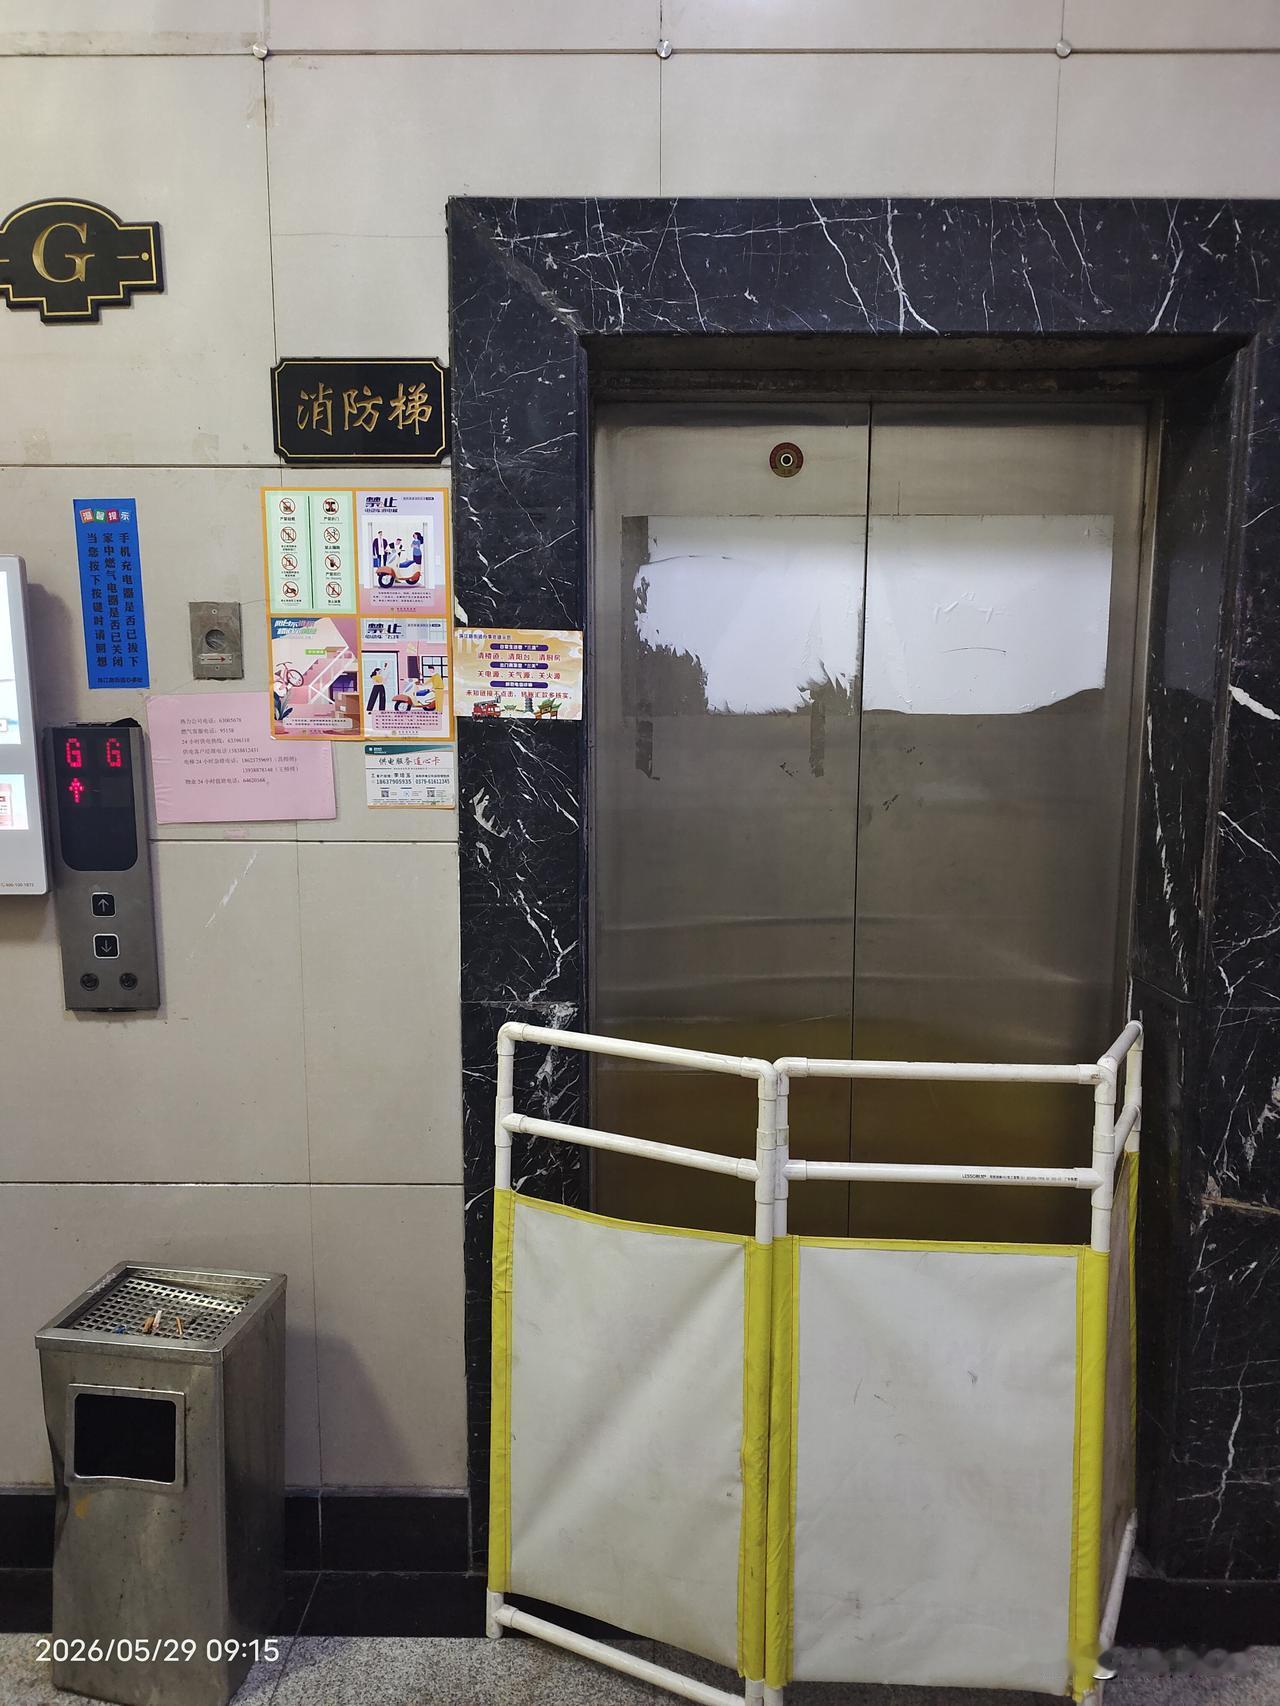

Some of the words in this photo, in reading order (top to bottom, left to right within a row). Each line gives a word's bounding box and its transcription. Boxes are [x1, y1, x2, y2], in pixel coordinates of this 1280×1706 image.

[32, 222, 96, 283] G
[297, 382, 434, 438] 消防梯
[82, 510, 130, 521] 温馨提示
[103, 532, 123, 667] 家中燃气电器是否已关闭
[119, 532, 139, 667] 手机充电器是否已拔下
[477, 652, 561, 662] 清楼道、清阳台、清厨房
[477, 671, 561, 680] 关电源、关气源、关火源
[65, 737, 82, 768] G
[106, 737, 122, 768] G
[379, 755, 441, 766] 供电服务连心卡
